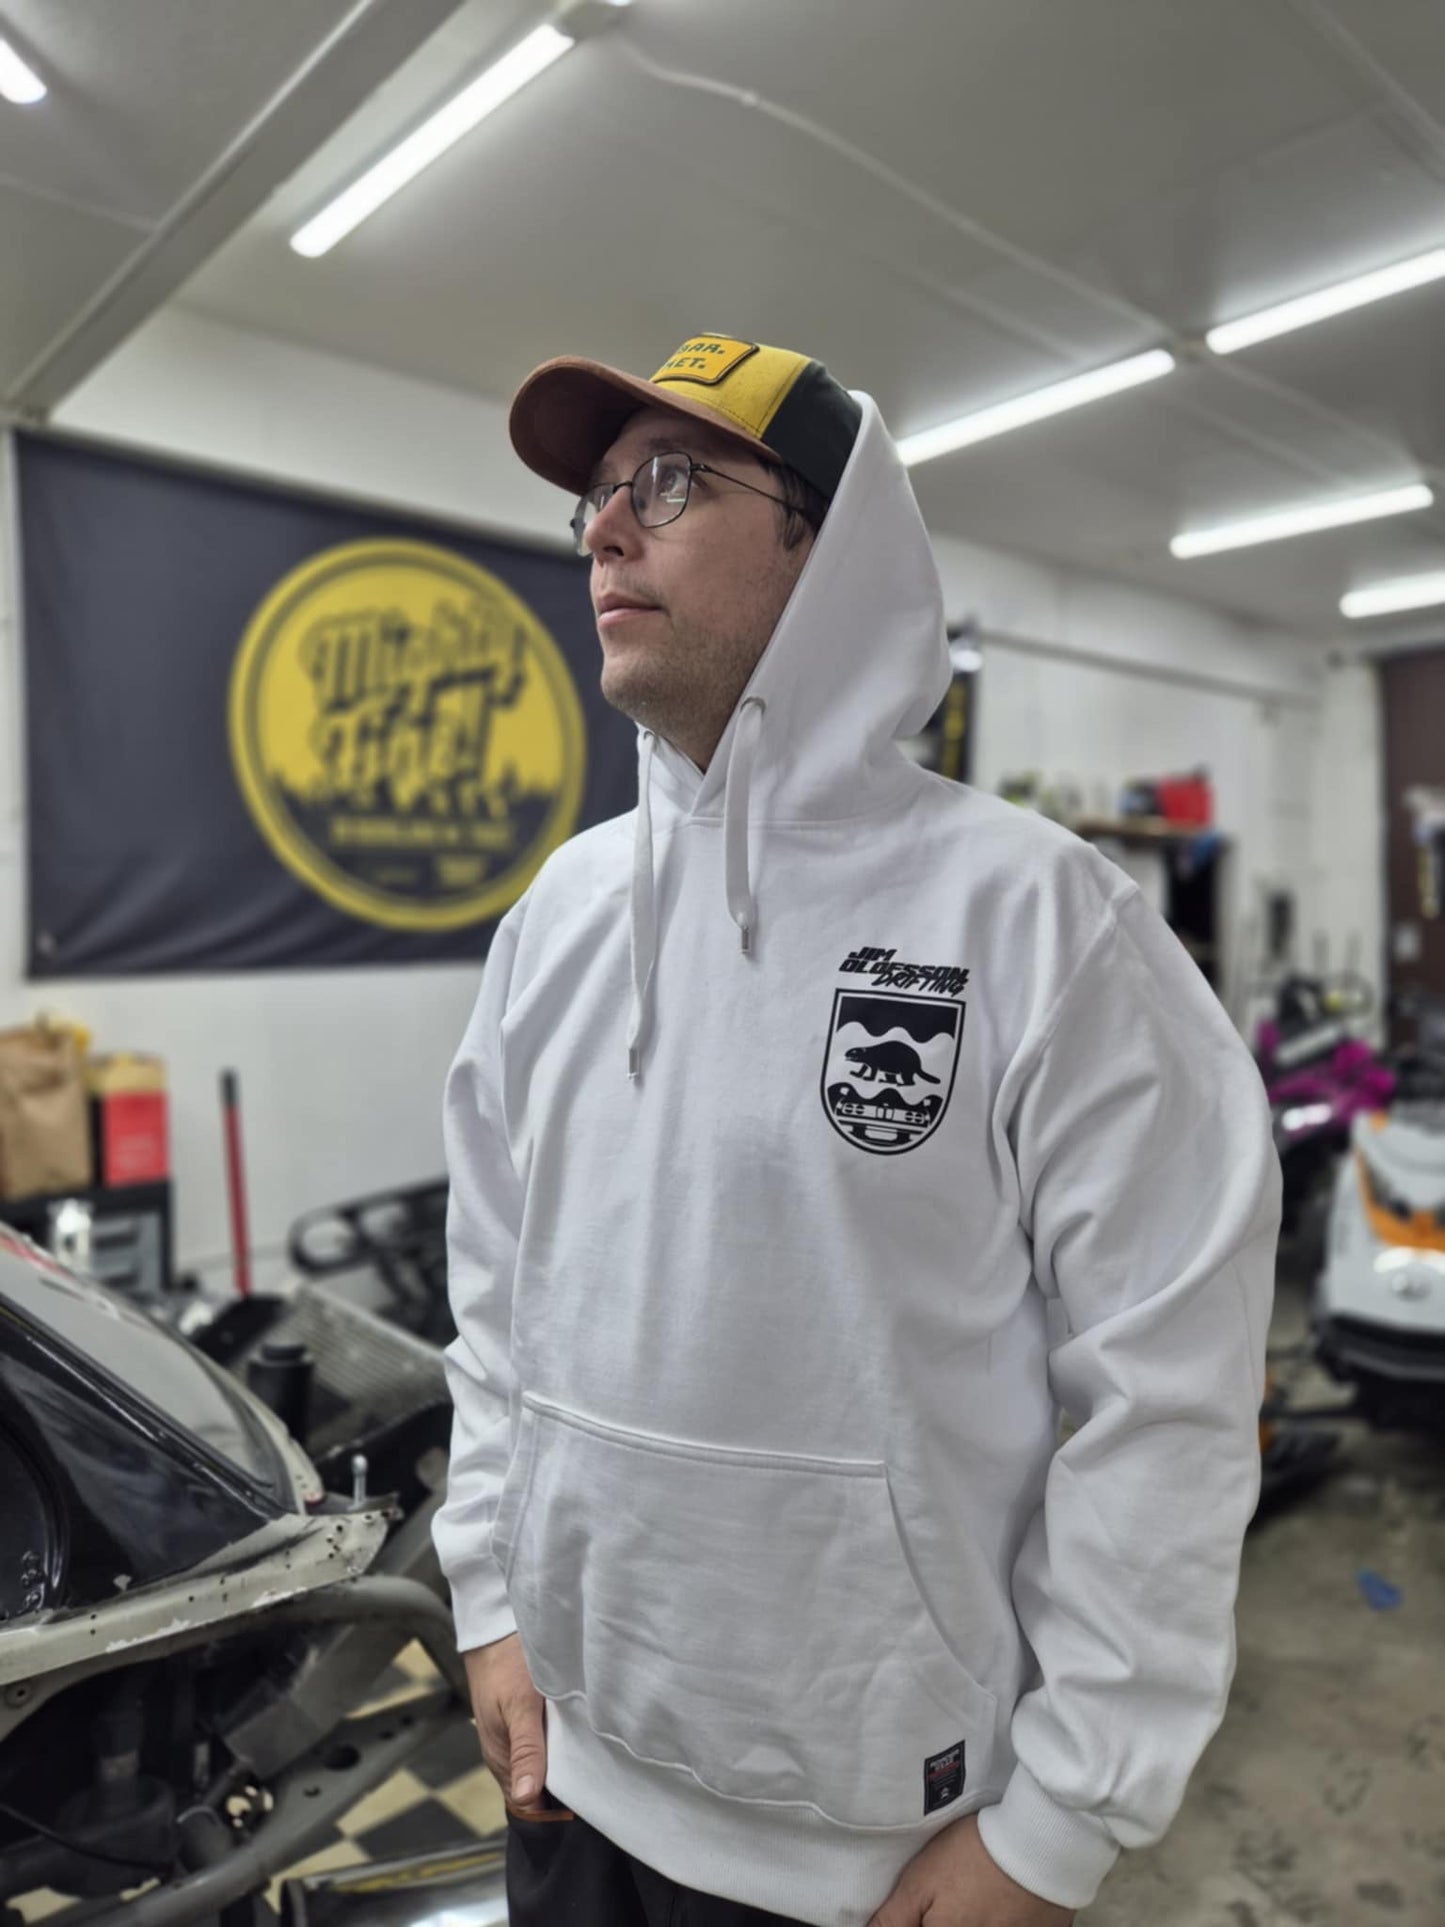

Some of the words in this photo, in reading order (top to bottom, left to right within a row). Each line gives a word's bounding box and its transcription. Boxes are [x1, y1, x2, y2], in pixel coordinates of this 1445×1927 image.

[848, 946, 897, 961] JIM
[838, 959, 970, 981] OLOFSSON
[871, 970, 968, 997] DRIFTING
